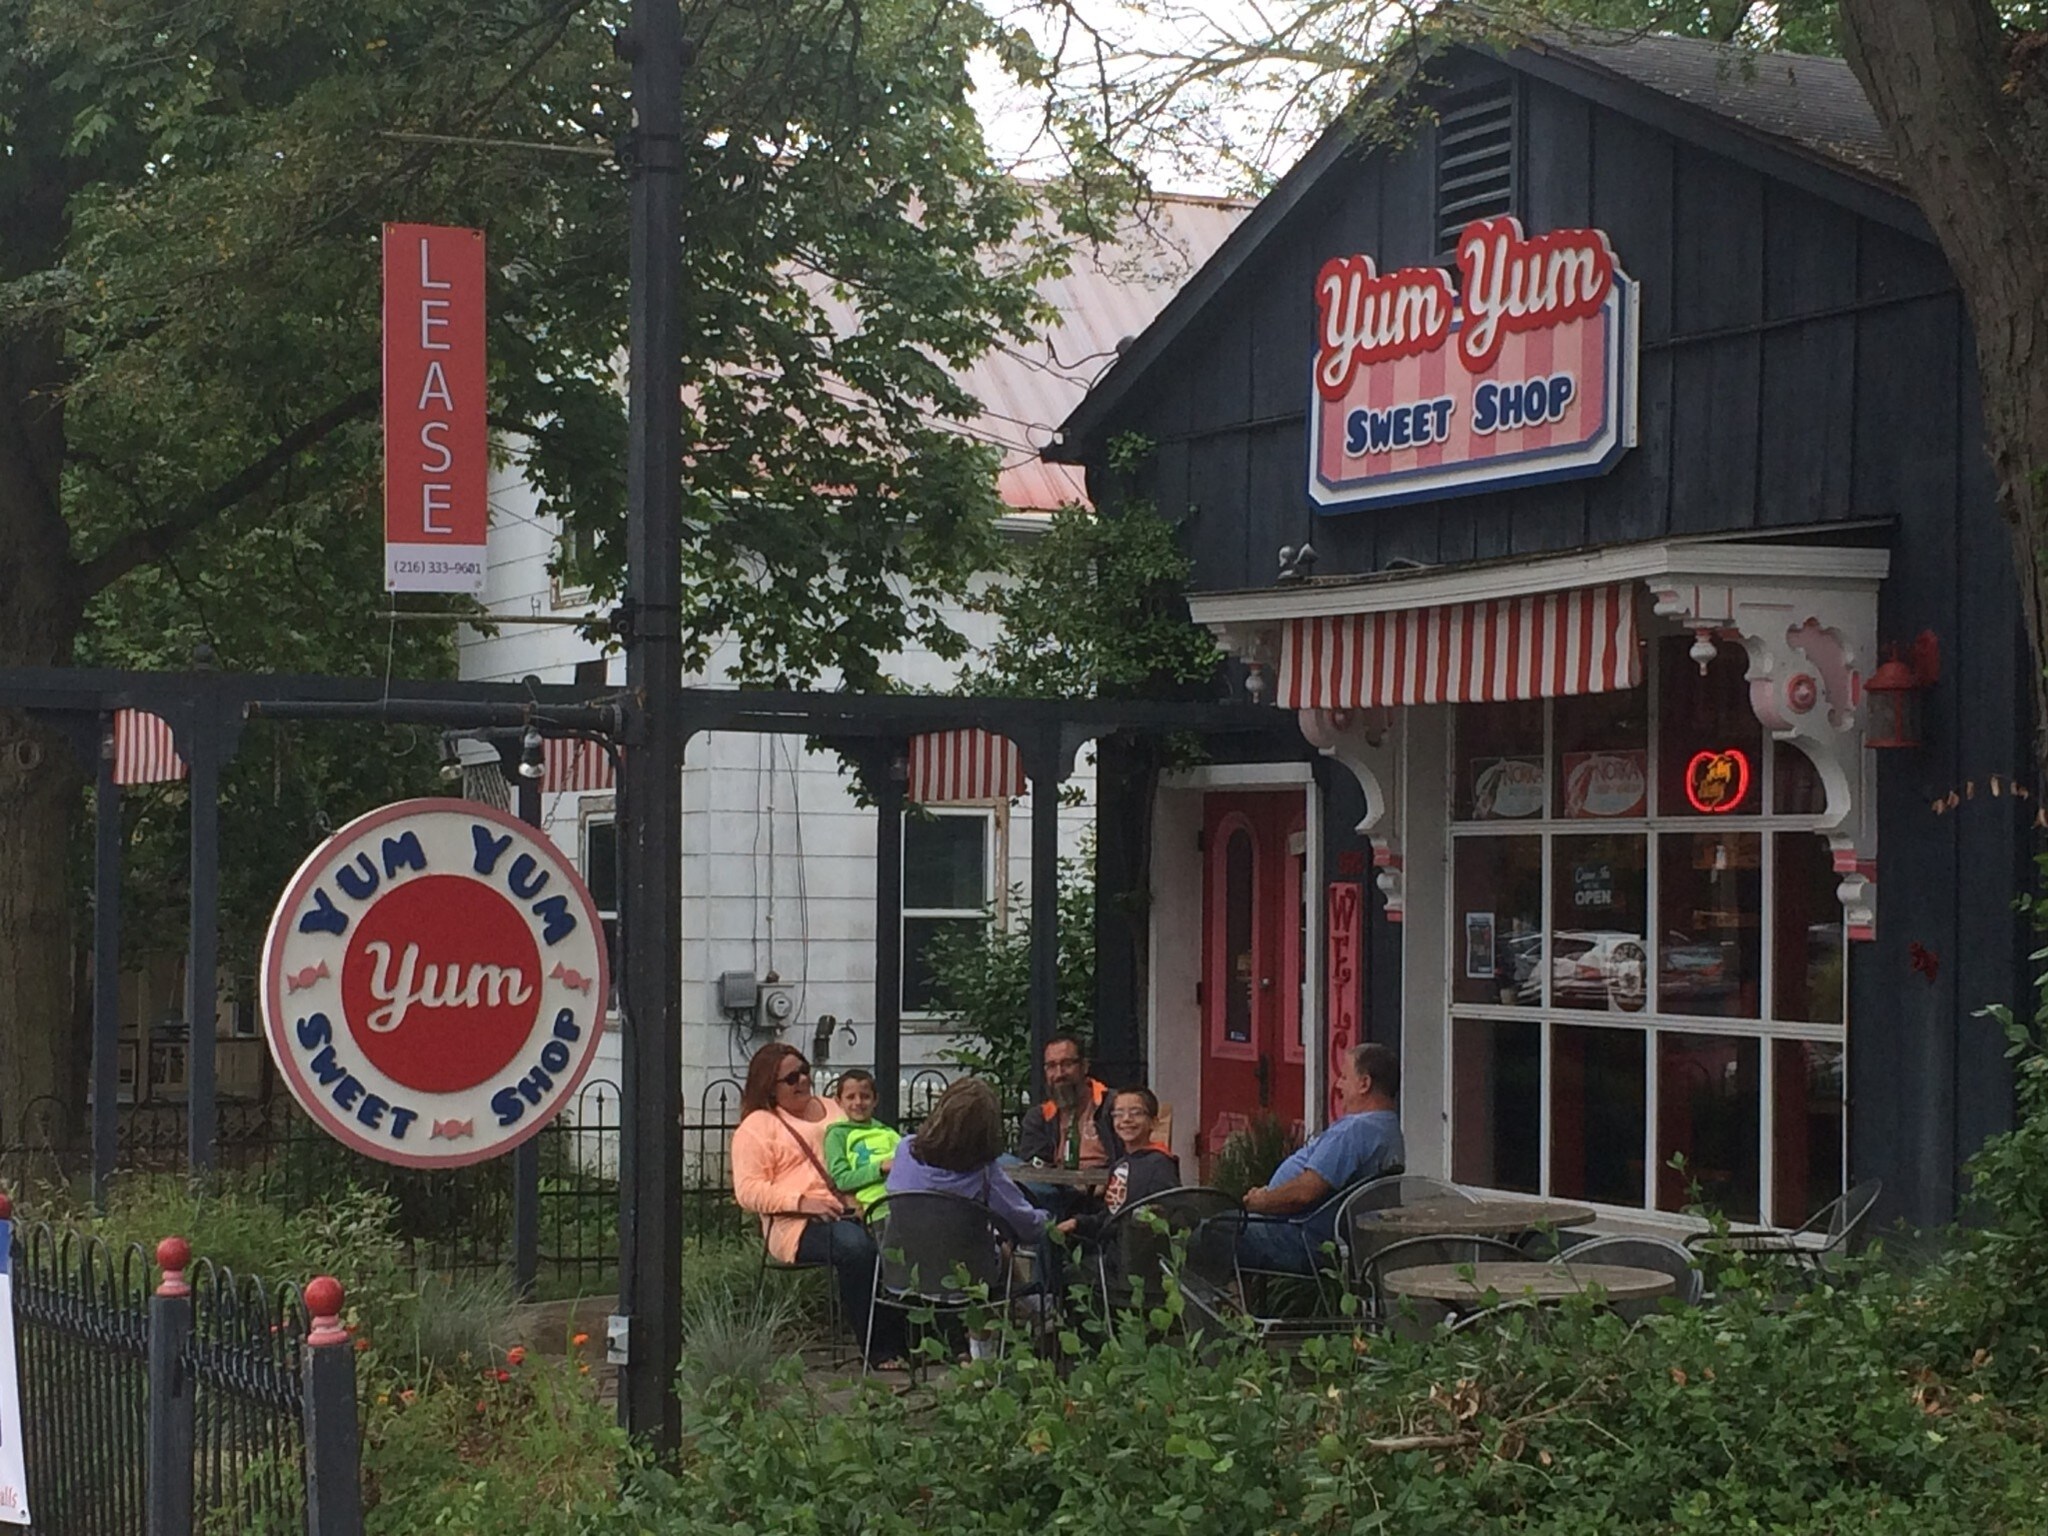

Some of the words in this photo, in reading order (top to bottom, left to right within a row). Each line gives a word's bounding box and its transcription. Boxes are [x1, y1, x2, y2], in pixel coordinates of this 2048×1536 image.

[1321, 271, 1447, 388] Yum
[1463, 234, 1604, 359] Yum
[417, 237, 454, 534] LEASE
[1345, 399, 1454, 454] SWEET
[1473, 376, 1573, 431] SHOP
[393, 560, 426, 575] (216)
[299, 830, 428, 936] YUM
[471, 823, 578, 946] YUM
[1574, 889, 1612, 906] OPEN
[364, 940, 534, 1034] Yum
[296, 1011, 419, 1140] SWEET
[490, 1006, 582, 1127] SHOP
